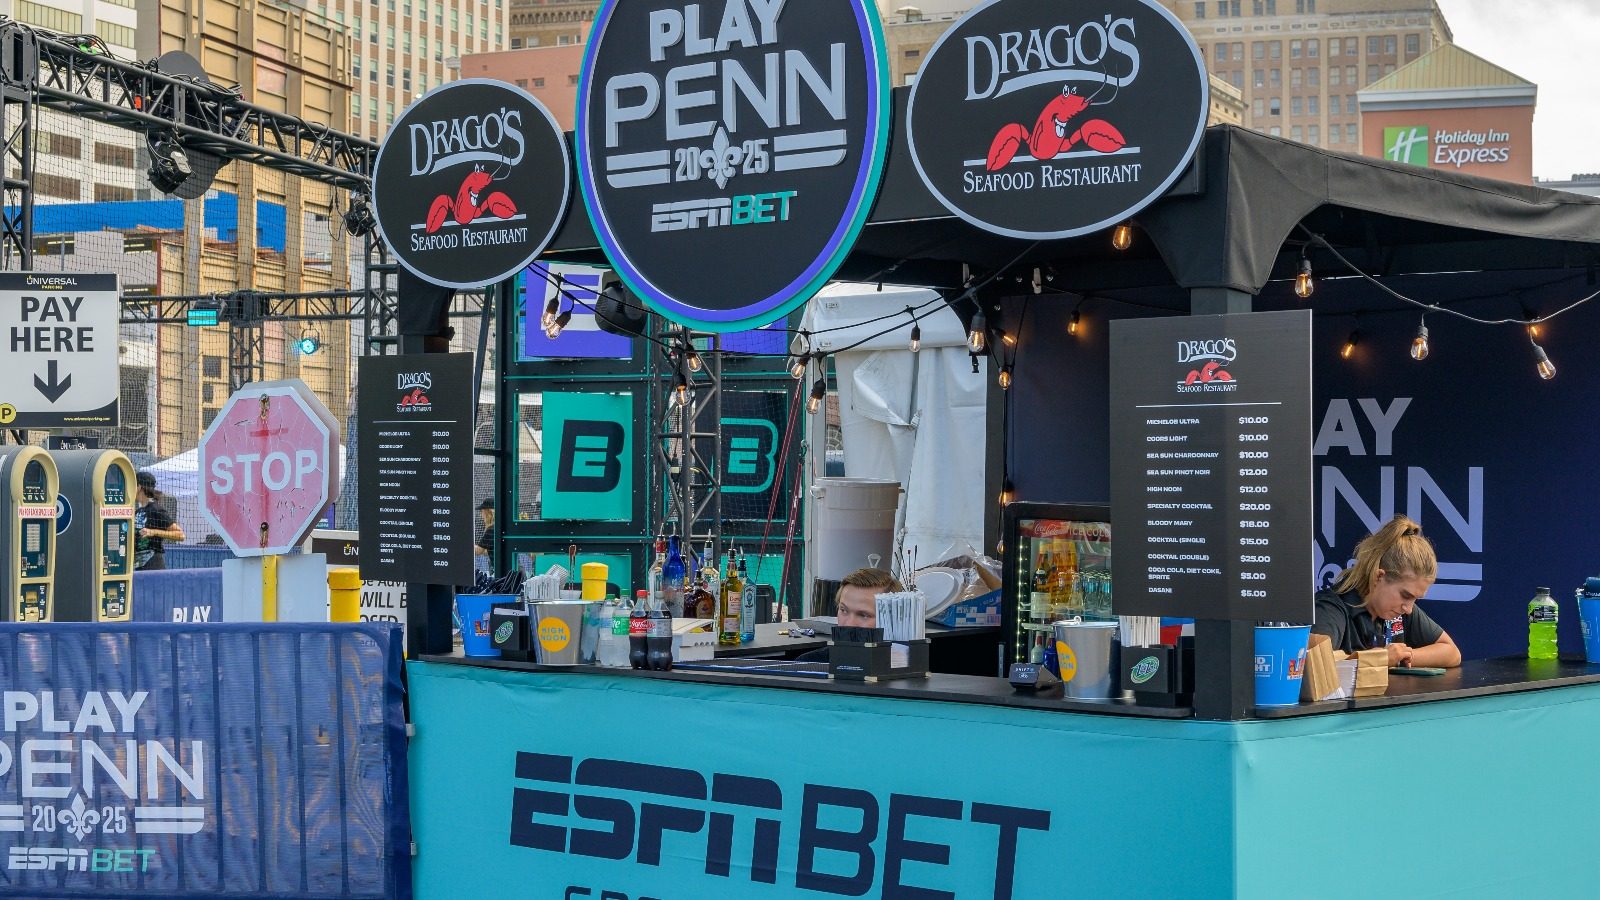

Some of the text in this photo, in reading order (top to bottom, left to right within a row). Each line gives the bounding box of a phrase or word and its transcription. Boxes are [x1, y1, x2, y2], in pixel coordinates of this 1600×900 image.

[650, 0, 787, 61] PLAY
[963, 14, 1140, 100] DRAGO'S
[605, 43, 847, 148] PENN
[408, 107, 525, 177] DRAGO'S
[1434, 128, 1509, 145] Holiday Inn
[1434, 145, 1509, 168] Express
[651, 190, 797, 233] ESPN BET
[27, 276, 78, 285] UNIVERSAL
[21, 296, 84, 322] PAY
[10, 327, 94, 353] HERE
[1177, 338, 1237, 363] DRAGO'S
[397, 371, 432, 389] DRAGO'S
[1312, 397, 1413, 455] AY
[1239, 451, 1269, 459] $10.00
[210, 450, 318, 495] STOP
[1239, 468, 1268, 476] $12.00
[1239, 485, 1269, 493] $12.00
[1239, 503, 1271, 511] $20.00
[1322, 466, 1484, 553] NN
[1239, 520, 1270, 528] $18.00
[1239, 537, 1269, 545] $15.00
[1240, 555, 1271, 563] $25.00
[1240, 572, 1267, 580] $5.00
[360, 591, 394, 609] WILL
[1240, 589, 1267, 598] $5.00
[541, 626, 564, 634] HIGH
[4, 690, 149, 733] PLAY
[510, 751, 1051, 900] ESPN BET
[8, 846, 156, 873] ESPN BET
